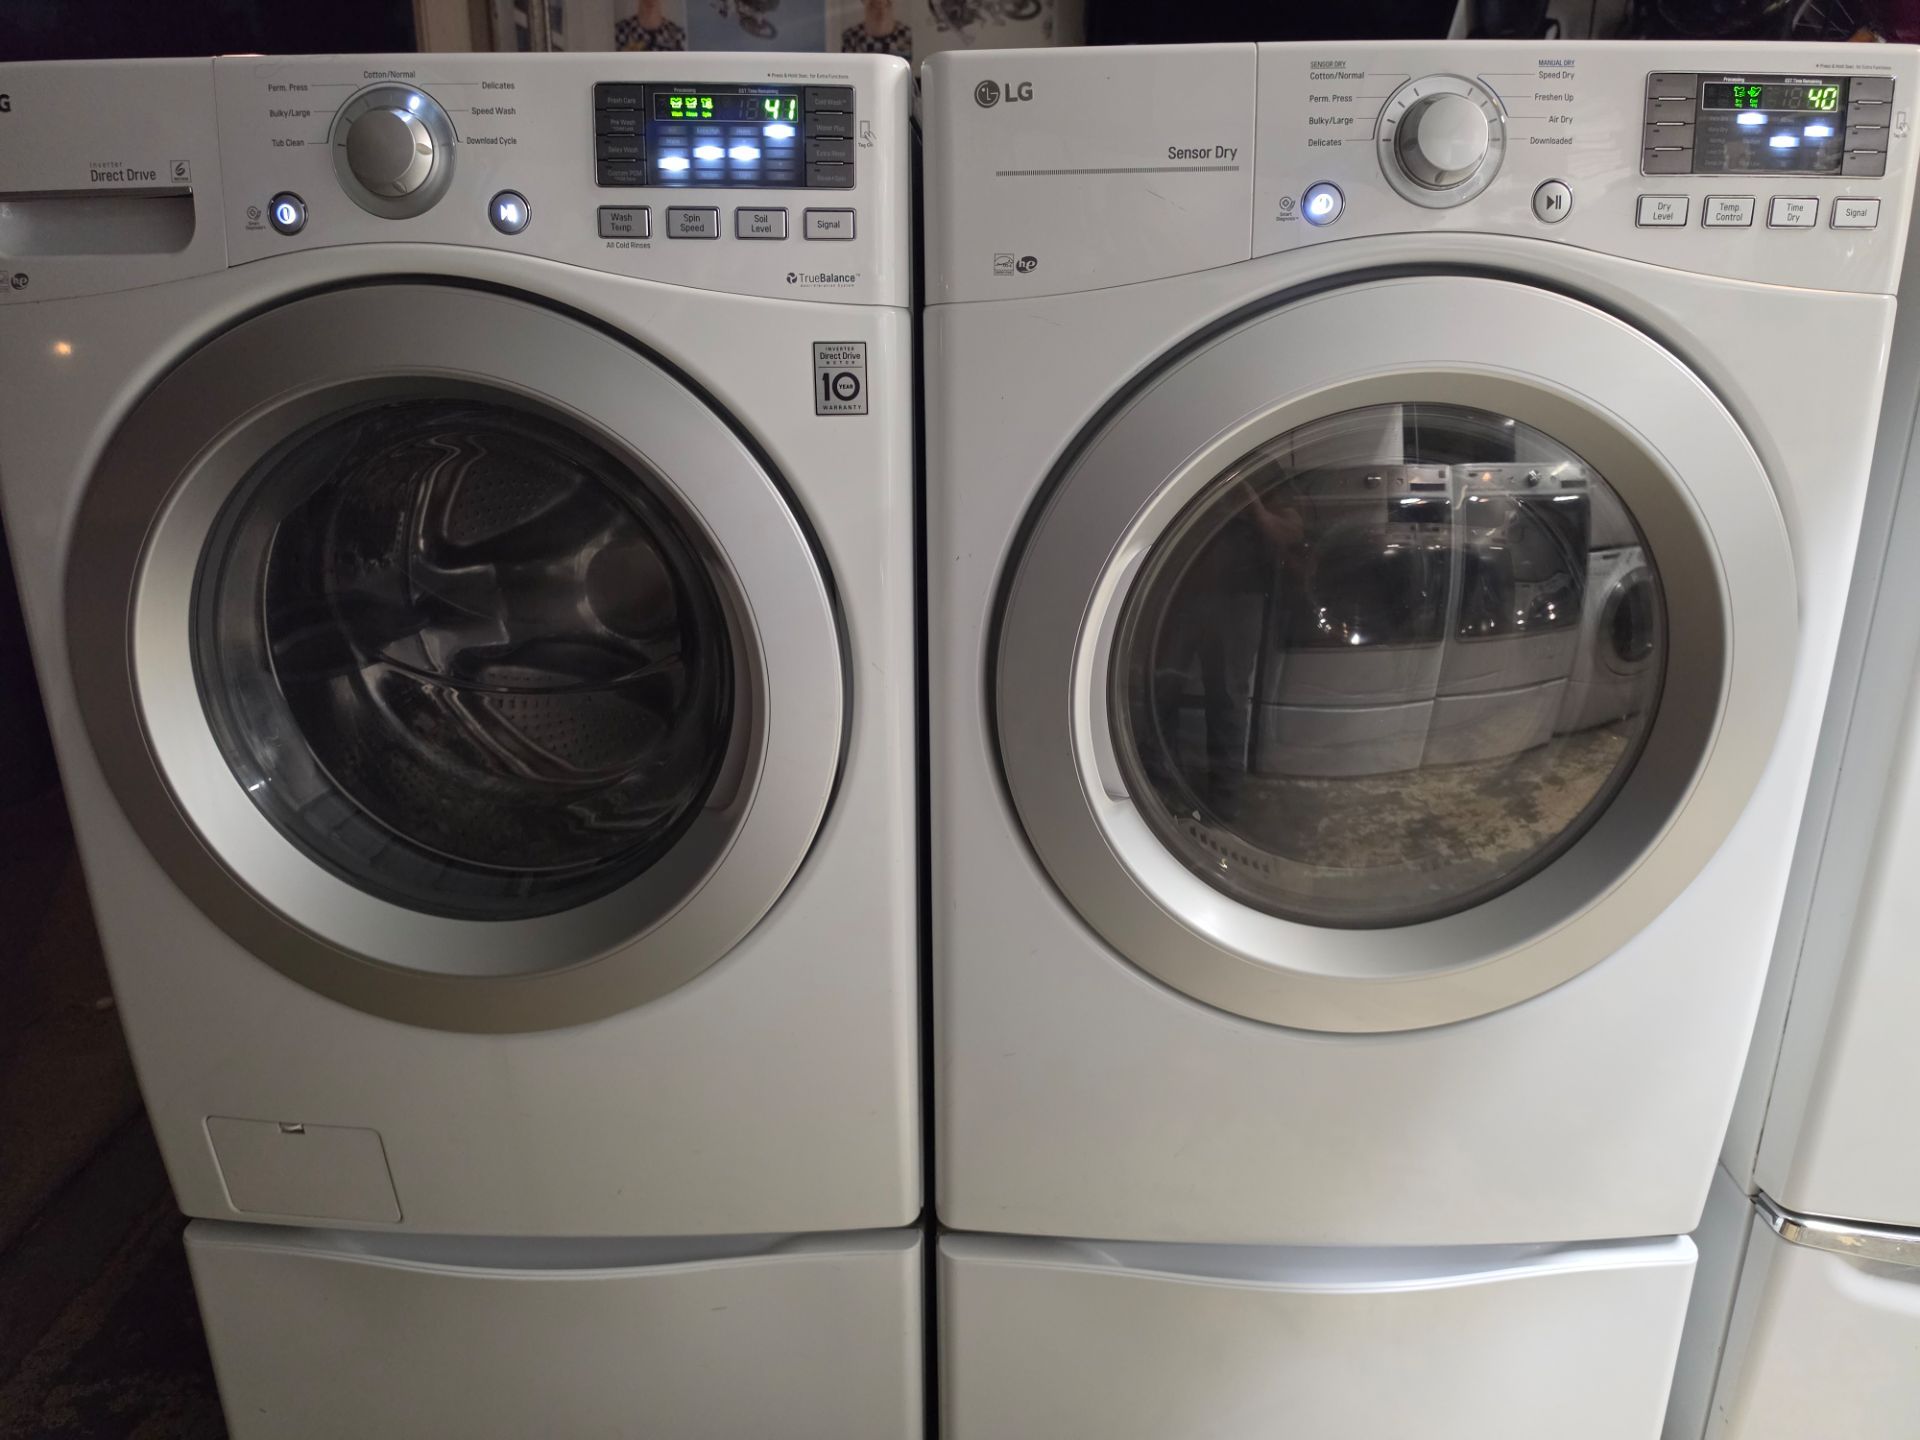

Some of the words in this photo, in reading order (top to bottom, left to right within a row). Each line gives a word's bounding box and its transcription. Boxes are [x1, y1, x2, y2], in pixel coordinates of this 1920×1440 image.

[363, 70, 416, 79] Cotton/Normal
[1310, 72, 1364, 80] Cotton/Normal
[1538, 70, 1561, 80] Speed
[1562, 70, 1576, 80] Dry
[268, 84, 287, 92] Perm.
[289, 84, 308, 92] Press
[482, 82, 515, 90] Delicates
[1004, 81, 1034, 102] LG
[1309, 94, 1330, 102] Perm.
[1332, 94, 1353, 102] Press
[1534, 92, 1563, 101] Freshen
[1564, 93, 1575, 103] Up
[1808, 88, 1838, 110] 40
[0, 94, 12, 112] G
[269, 109, 311, 118] Bulky/Large
[472, 107, 493, 116] Speed
[495, 107, 516, 115] Wash
[764, 98, 796, 120] 41
[1308, 116, 1354, 126] Bulky/Large
[1560, 116, 1573, 125] Dry
[272, 139, 284, 147] Tub
[285, 139, 304, 147] Clean
[466, 136, 497, 145] Download
[498, 136, 517, 146] Cycle
[1307, 138, 1342, 147] Delicates
[1530, 136, 1573, 145] Downloaded
[1168, 146, 1212, 160] Sensor
[1214, 146, 1238, 161] Dry
[90, 169, 125, 182] Direct
[126, 168, 158, 182] Drive
[1658, 202, 1672, 212] Dry
[1720, 203, 1740, 213] Temp
[1786, 203, 1804, 212] Time
[610, 213, 632, 222] Wash
[683, 213, 700, 223] Spin
[754, 214, 768, 223] Soil
[1653, 212, 1674, 221] Level
[1716, 212, 1744, 222] Control
[1786, 212, 1800, 222] Dry
[1845, 208, 1868, 219] Signal
[680, 223, 704, 233] Speed
[751, 224, 772, 233] Level
[817, 220, 840, 231] Signal
[822, 372, 860, 401] 10
